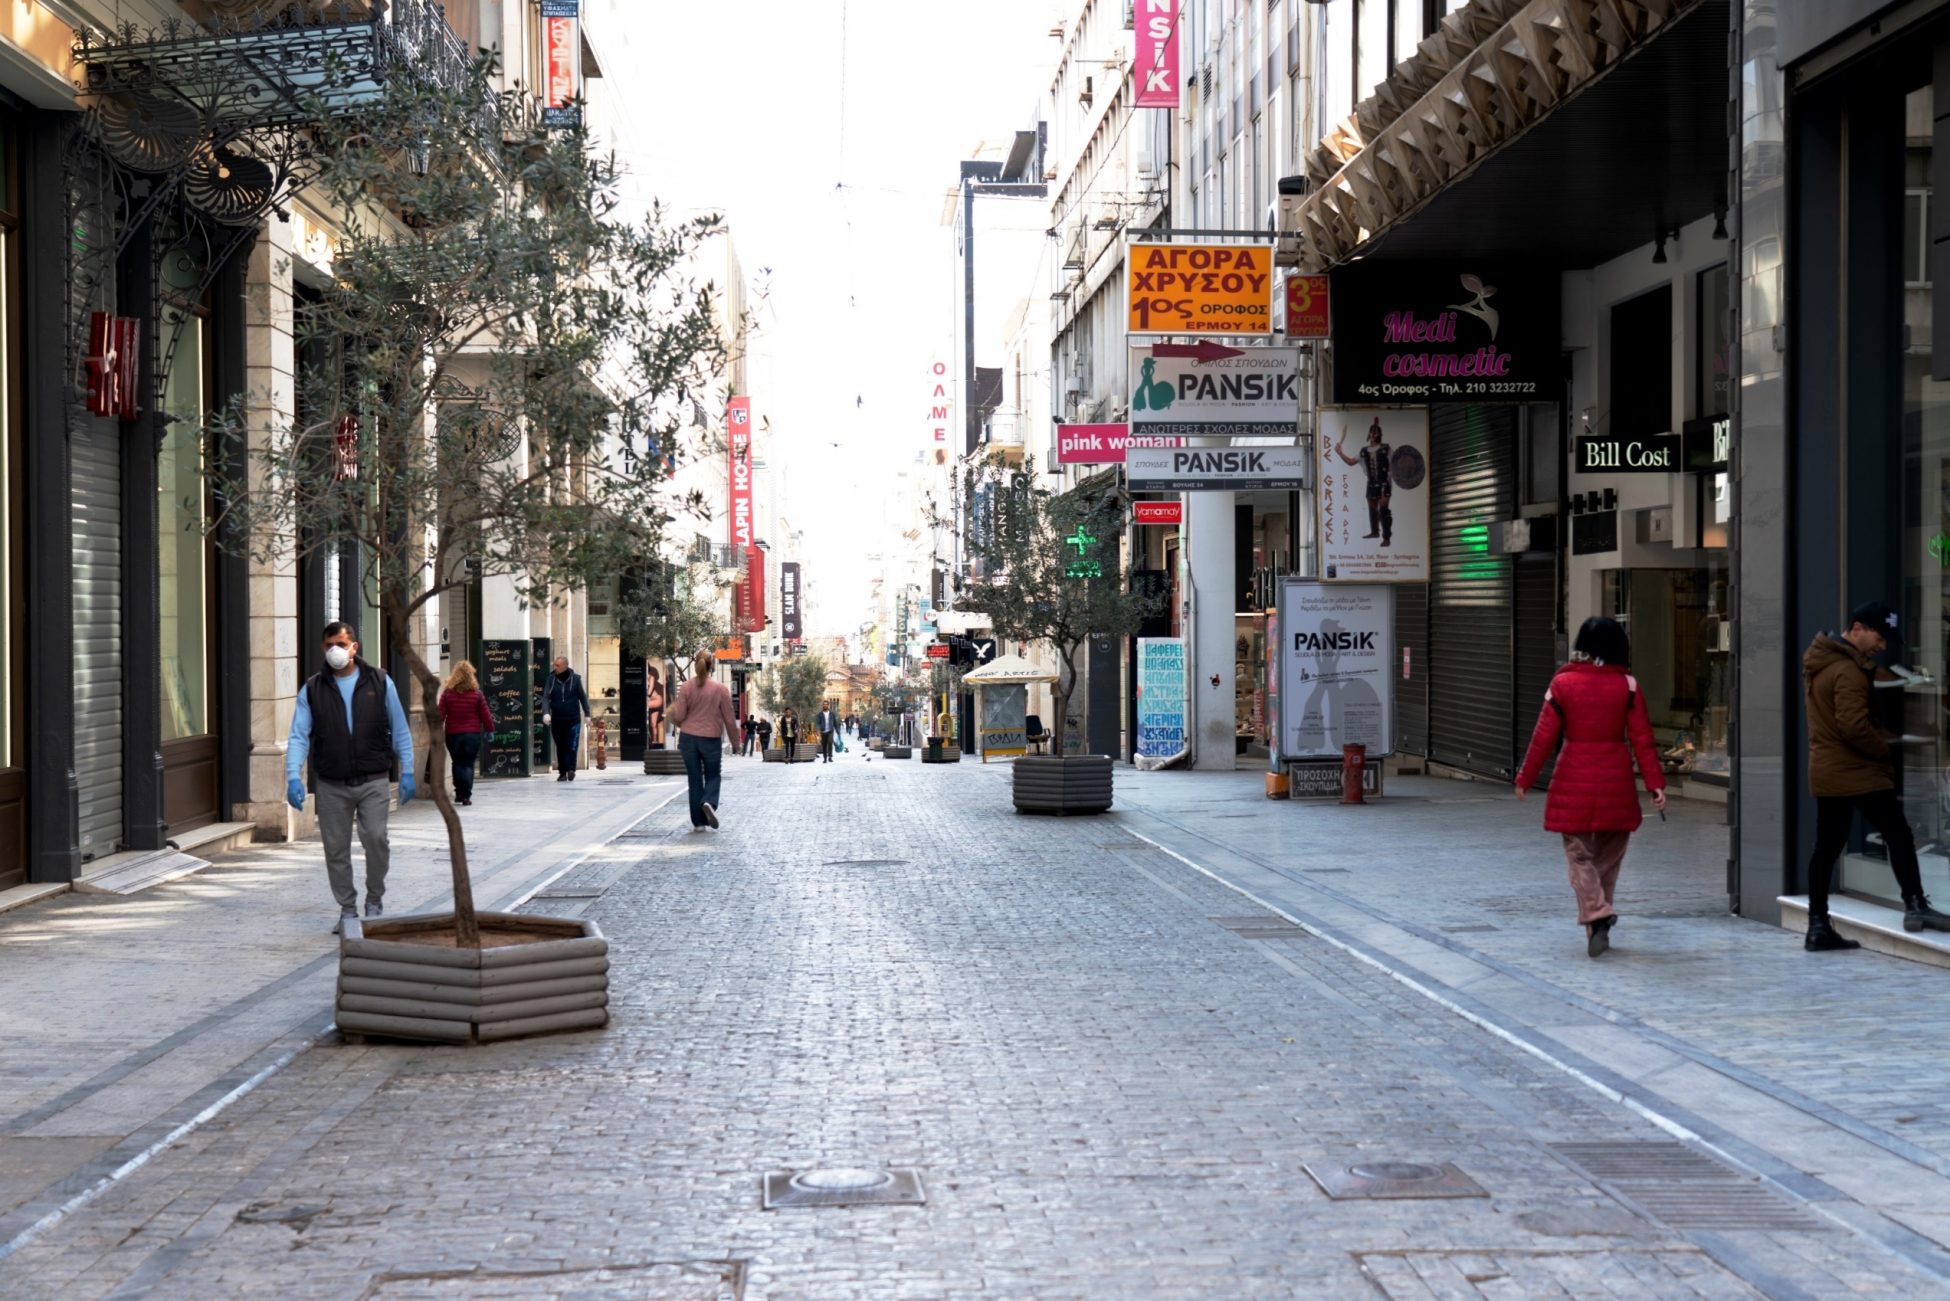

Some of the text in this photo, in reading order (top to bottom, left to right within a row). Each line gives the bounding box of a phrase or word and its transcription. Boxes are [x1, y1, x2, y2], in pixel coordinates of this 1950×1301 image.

[1146, 249, 1256, 270] ΑΓΟΡΑ
[1133, 272, 1267, 293] ΧΡΥΣΟΥ
[1200, 304, 1267, 315] ΟΡΟΦΟΣ
[1185, 321, 1267, 331] ΕΡΜΟΥ 14
[1382, 310, 1458, 343] Medi
[1234, 359, 1288, 368] ΣΠΟΥΔΩΝ
[1382, 345, 1512, 378] cosmetic
[1358, 383, 1380, 396] 4ος
[1439, 383, 1463, 396] Τηλ.
[1466, 383, 1487, 393] 210
[1489, 382, 1536, 393] 3232722
[1139, 424, 1295, 434] ΑΝΩΤΕΡΕΣ ΣΧΟΛΕΣ ΜΟΔΑΣ
[1061, 433, 1177, 455] pink woman
[1584, 441, 1672, 467] Bill Cost
[1323, 435, 1334, 545] BE GREEK
[735, 497, 750, 547] LAPIN
[498, 690, 520, 699] coffee
[1296, 769, 1340, 780] ΠΡΟΣΟΧΗ
